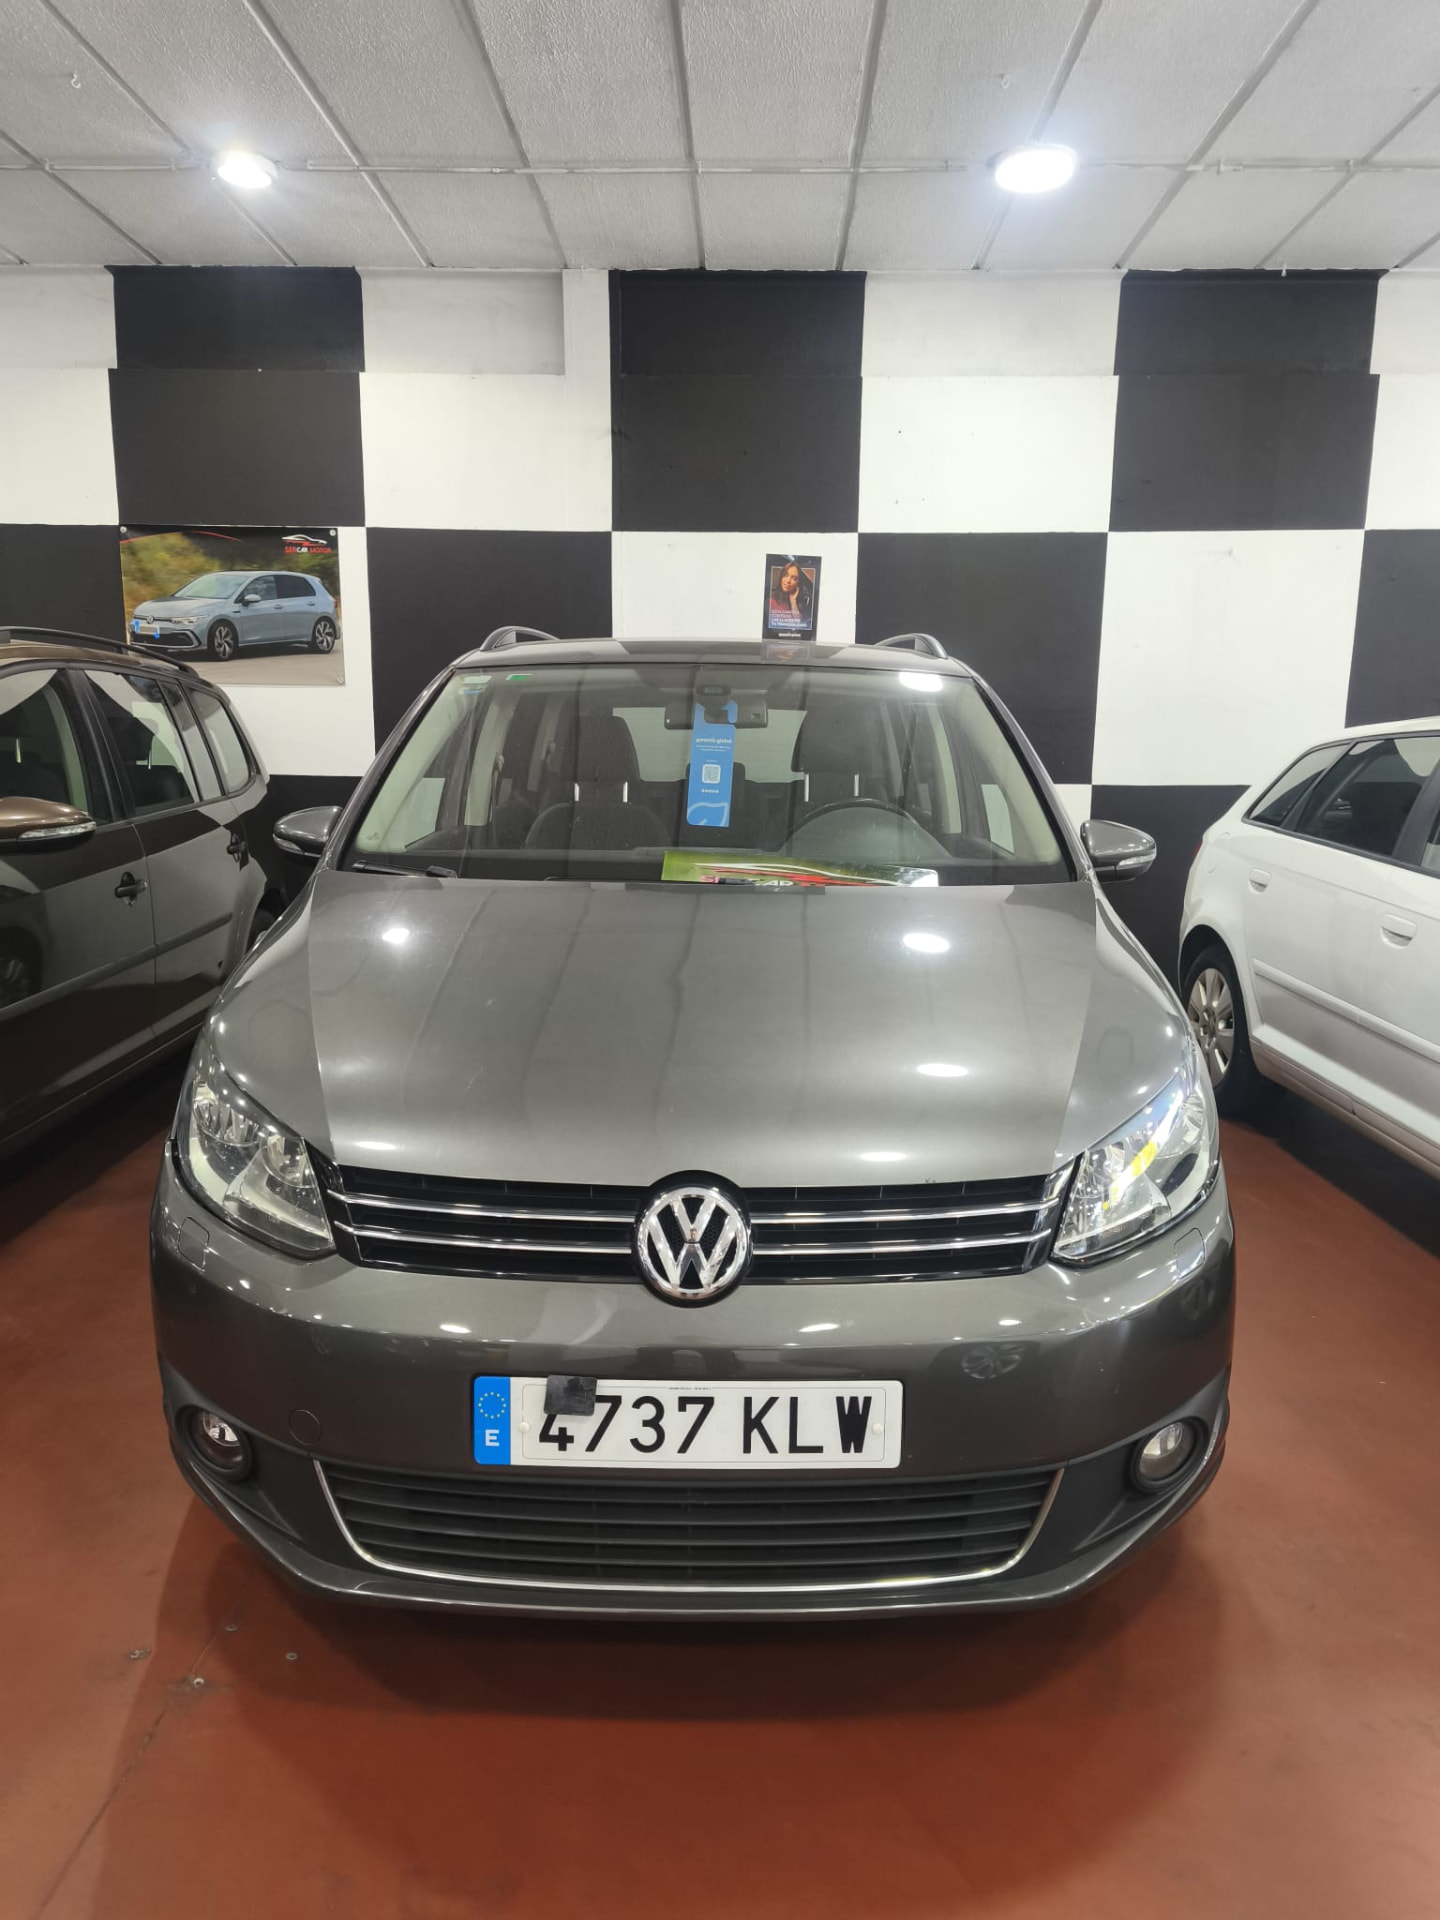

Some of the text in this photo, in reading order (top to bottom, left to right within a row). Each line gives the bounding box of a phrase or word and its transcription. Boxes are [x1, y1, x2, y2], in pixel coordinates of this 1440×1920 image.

[485, 1430, 499, 1446] E
[539, 1396, 872, 1454] 4737 KLW
